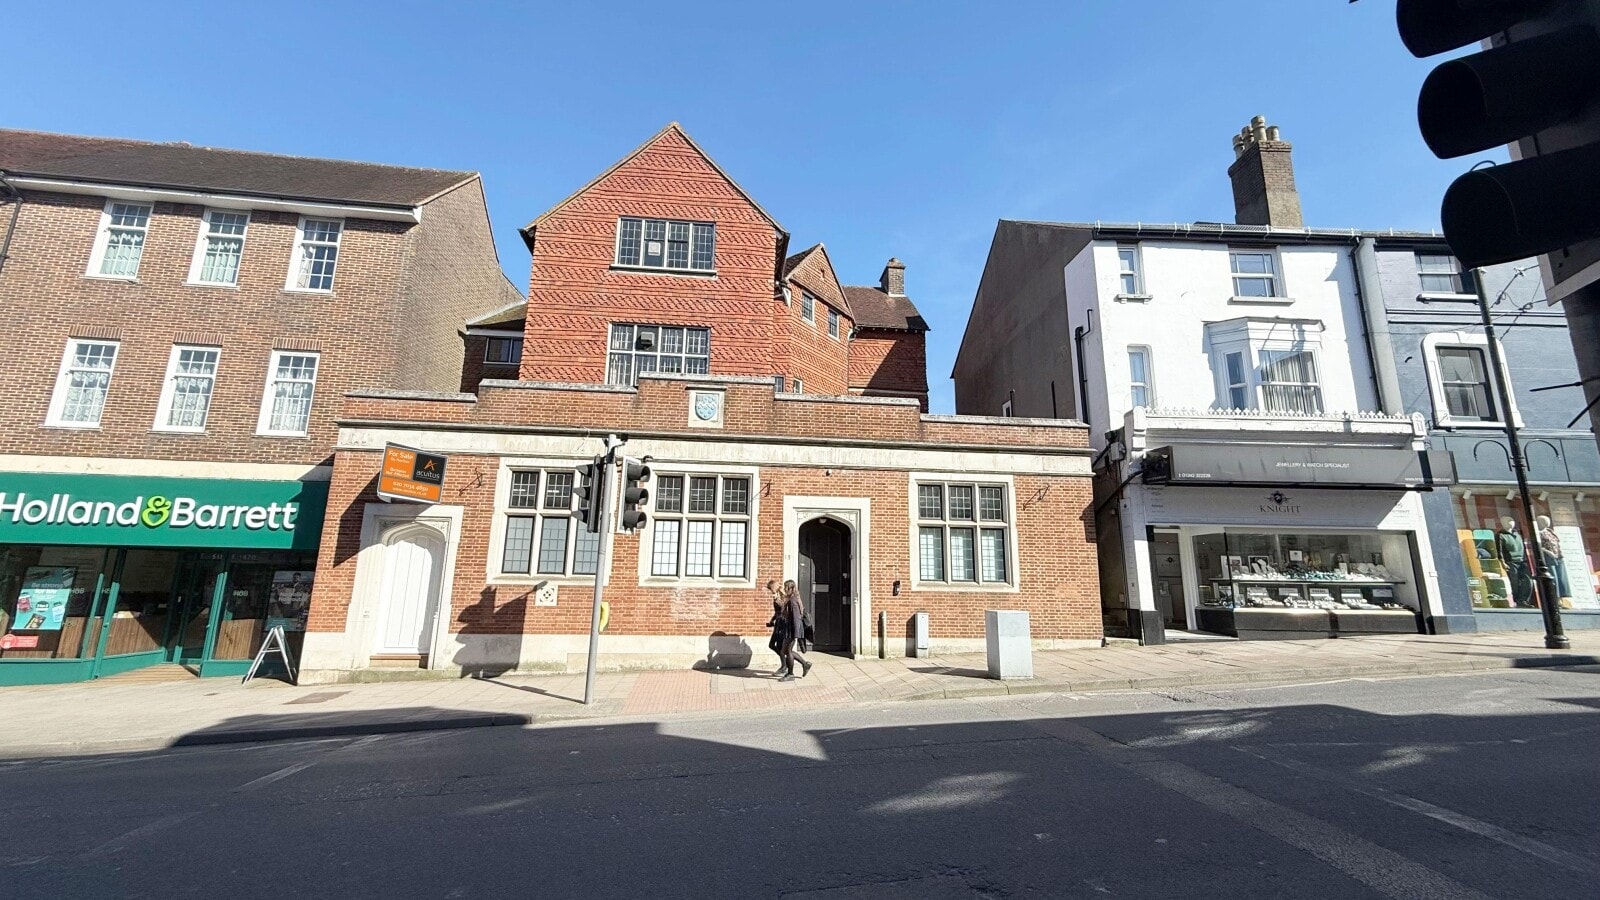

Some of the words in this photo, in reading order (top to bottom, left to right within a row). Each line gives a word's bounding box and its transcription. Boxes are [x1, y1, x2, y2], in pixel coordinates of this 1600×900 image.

[400, 452, 414, 460] Sale
[416, 470, 440, 479] acuitus
[1259, 505, 1301, 513] KNIGHT
